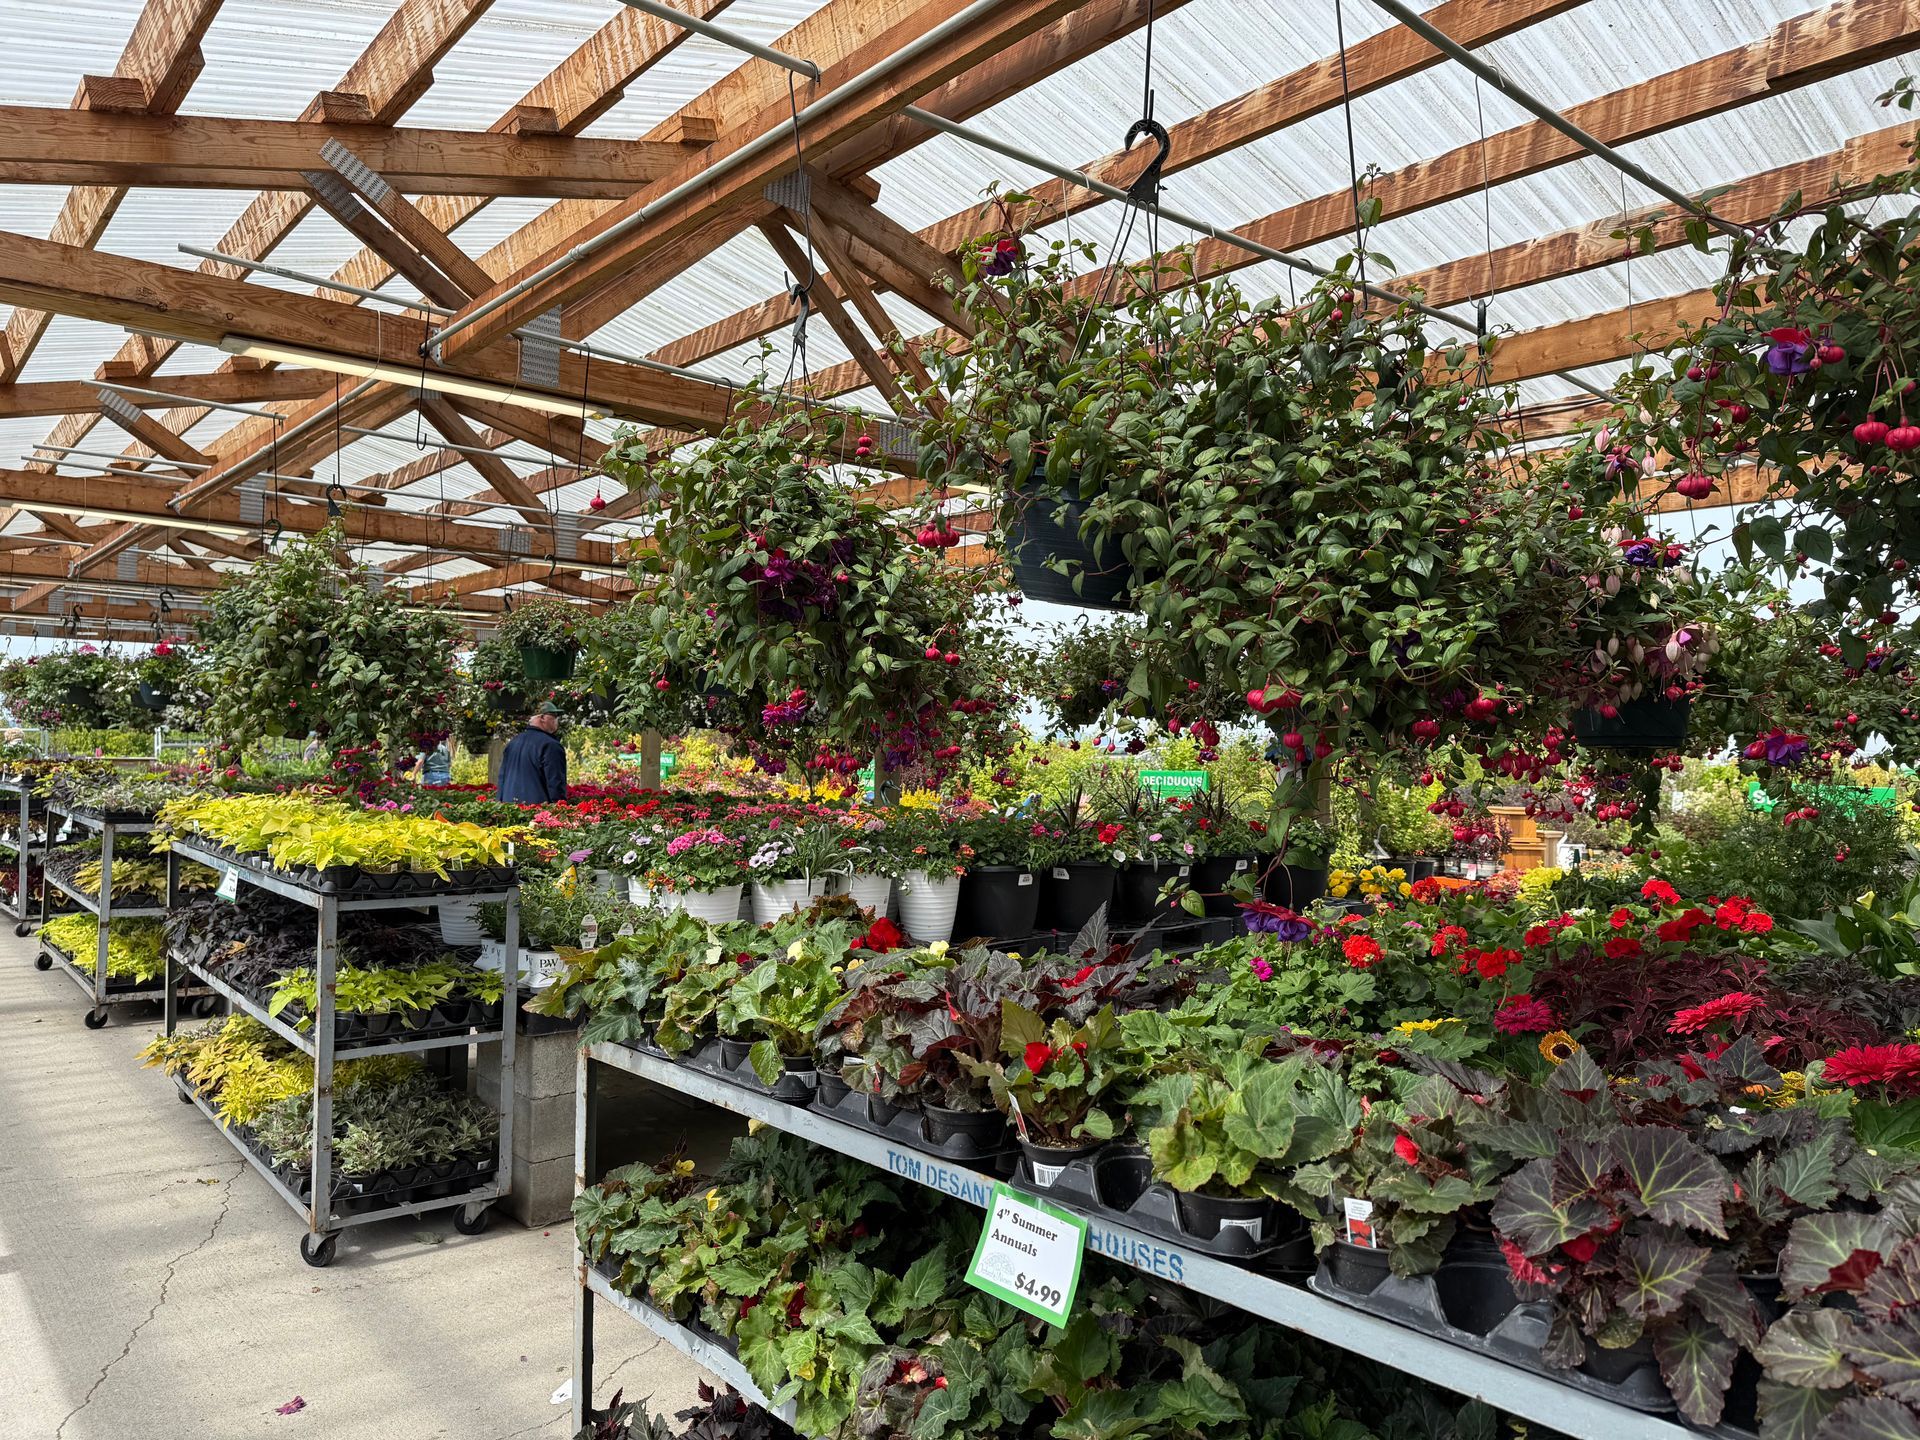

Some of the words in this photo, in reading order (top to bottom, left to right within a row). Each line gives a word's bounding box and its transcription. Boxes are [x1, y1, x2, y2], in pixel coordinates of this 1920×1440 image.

[1142, 775, 1203, 787] DECIDUOUS
[887, 1149, 921, 1181] TOM
[1011, 1212, 1058, 1242] Summer
[991, 1228, 1038, 1257] Annuals
[1014, 1272, 1061, 1307] $4.99
